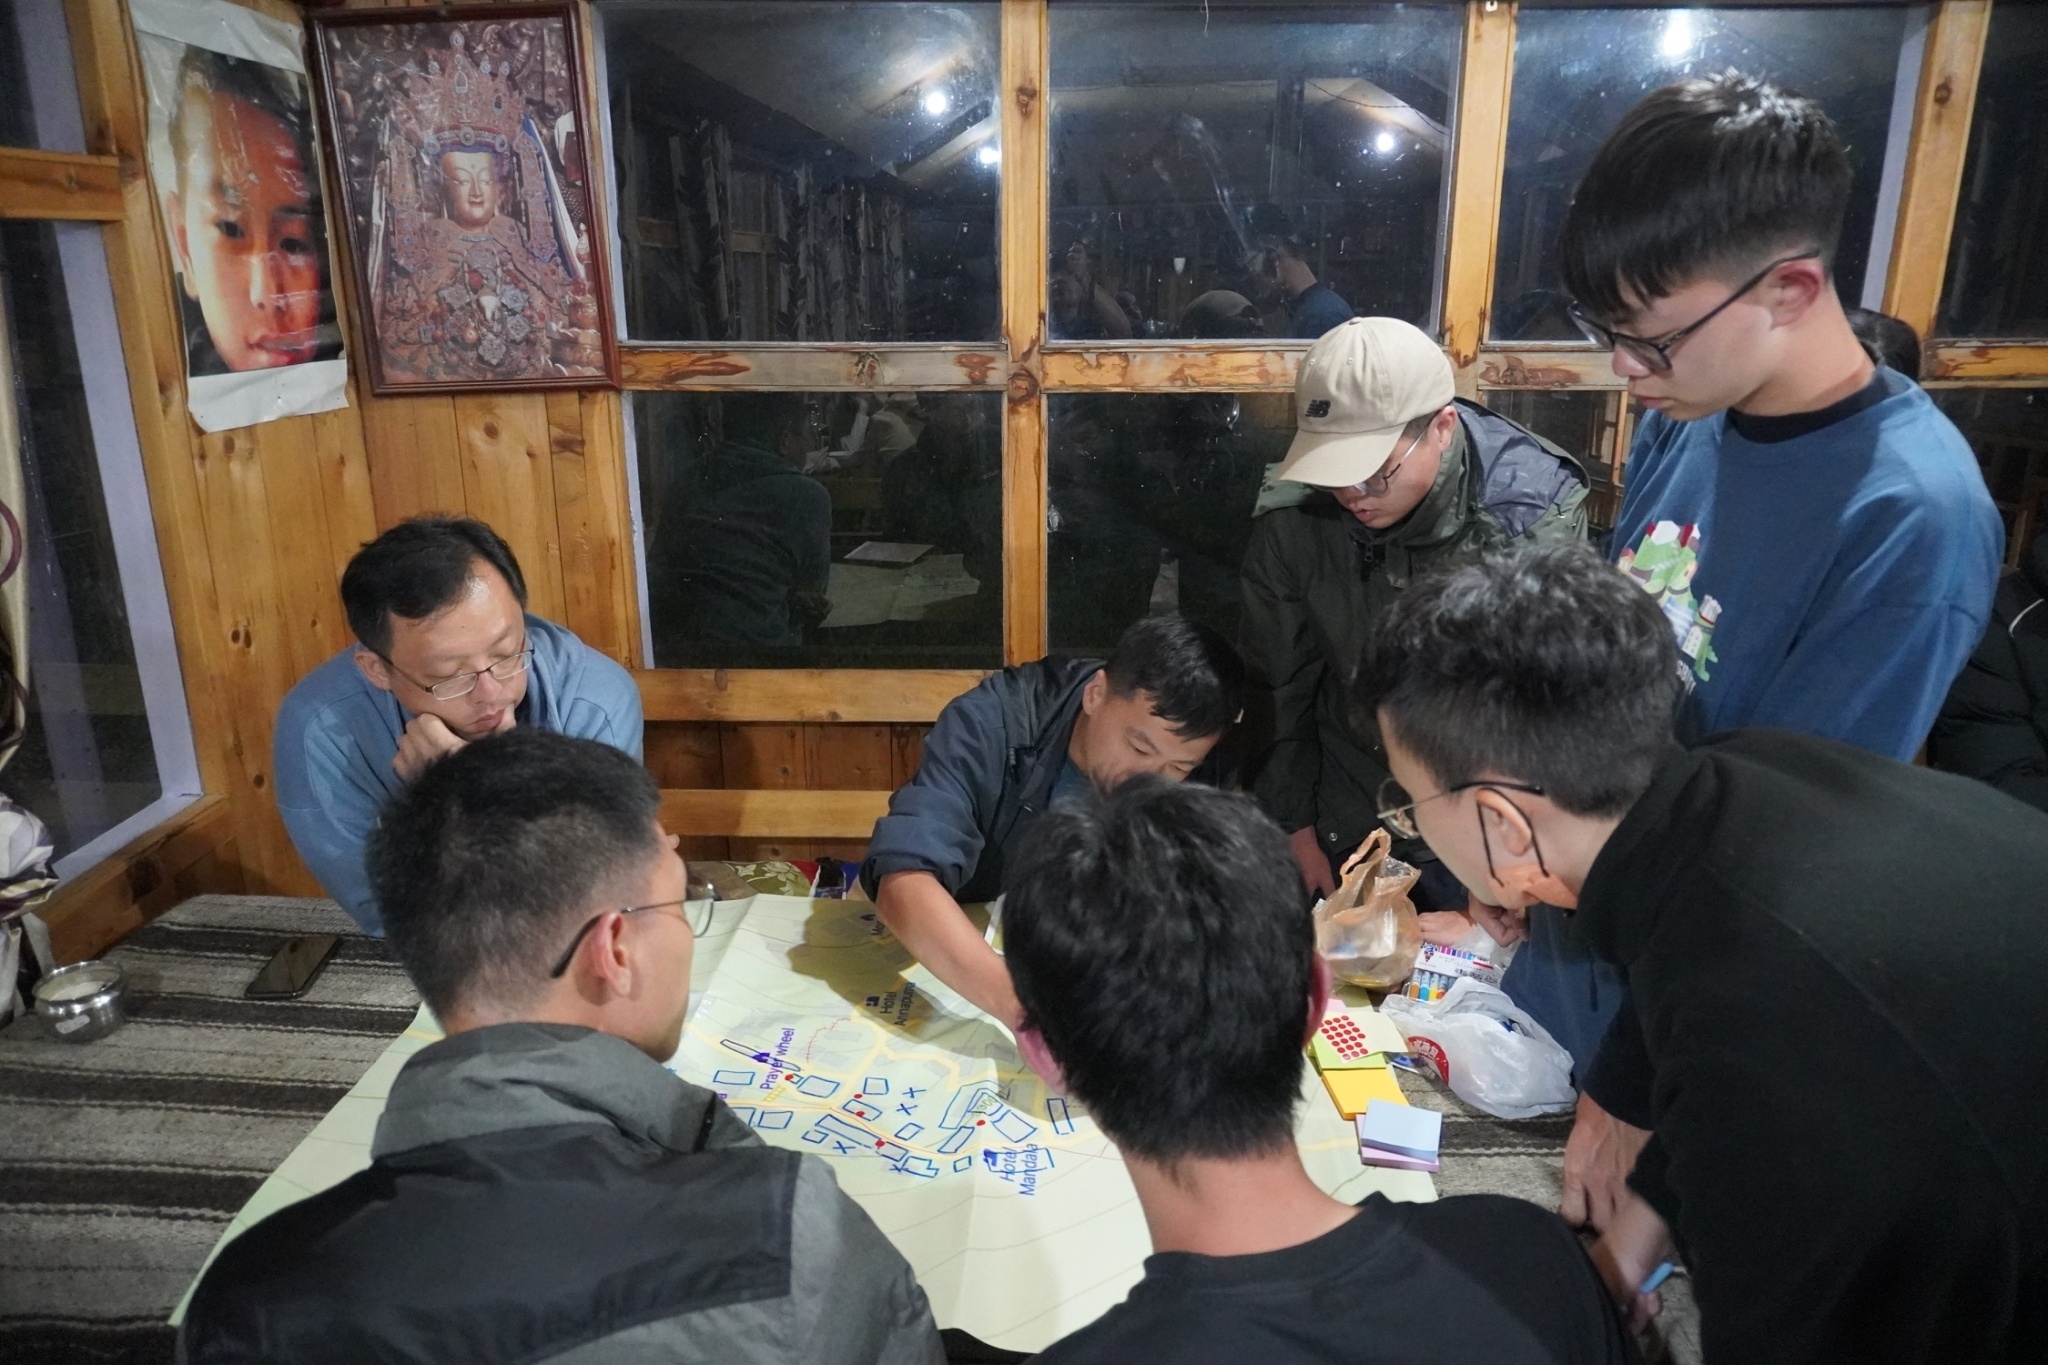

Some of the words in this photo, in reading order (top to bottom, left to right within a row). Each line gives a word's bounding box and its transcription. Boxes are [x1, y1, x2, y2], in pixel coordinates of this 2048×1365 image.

[879, 991, 897, 1014] Hotel
[760, 1056, 783, 1090] Prayer
[775, 1027, 795, 1056] wheel
[999, 1146, 1017, 1182] Hotel
[1018, 1143, 1038, 1197] Mandala
